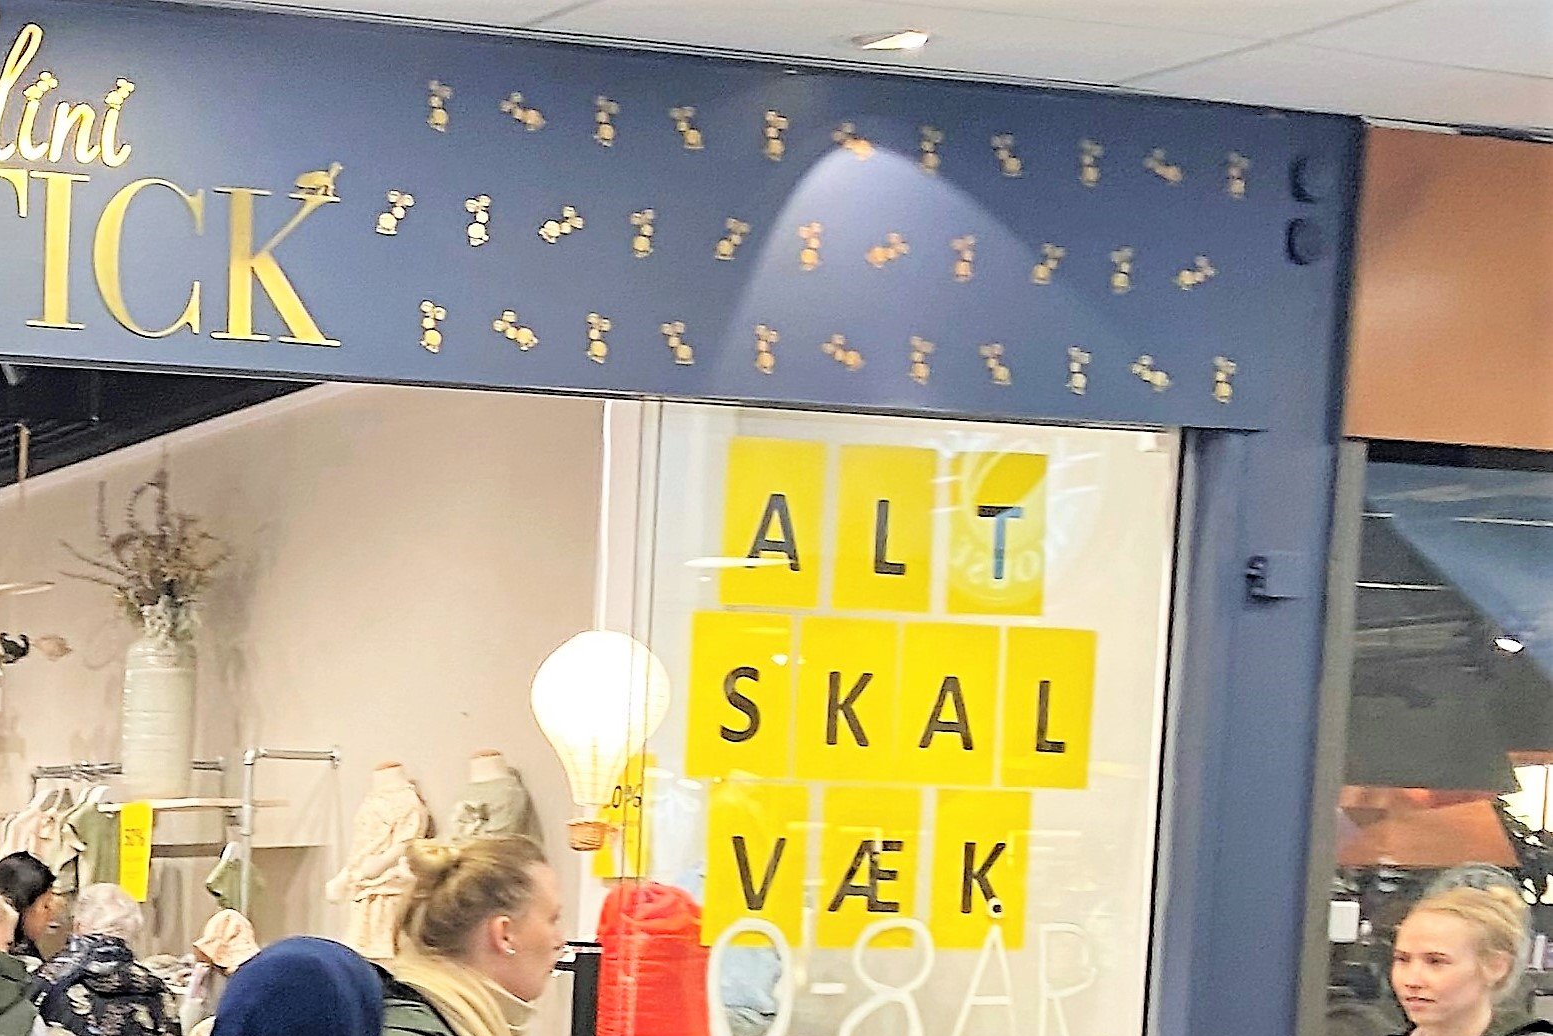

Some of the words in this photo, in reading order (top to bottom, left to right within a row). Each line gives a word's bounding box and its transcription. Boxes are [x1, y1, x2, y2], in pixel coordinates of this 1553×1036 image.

[745, 493, 1024, 580] ALT
[720, 666, 1067, 754] SKAL
[732, 836, 1007, 915] VÆK
